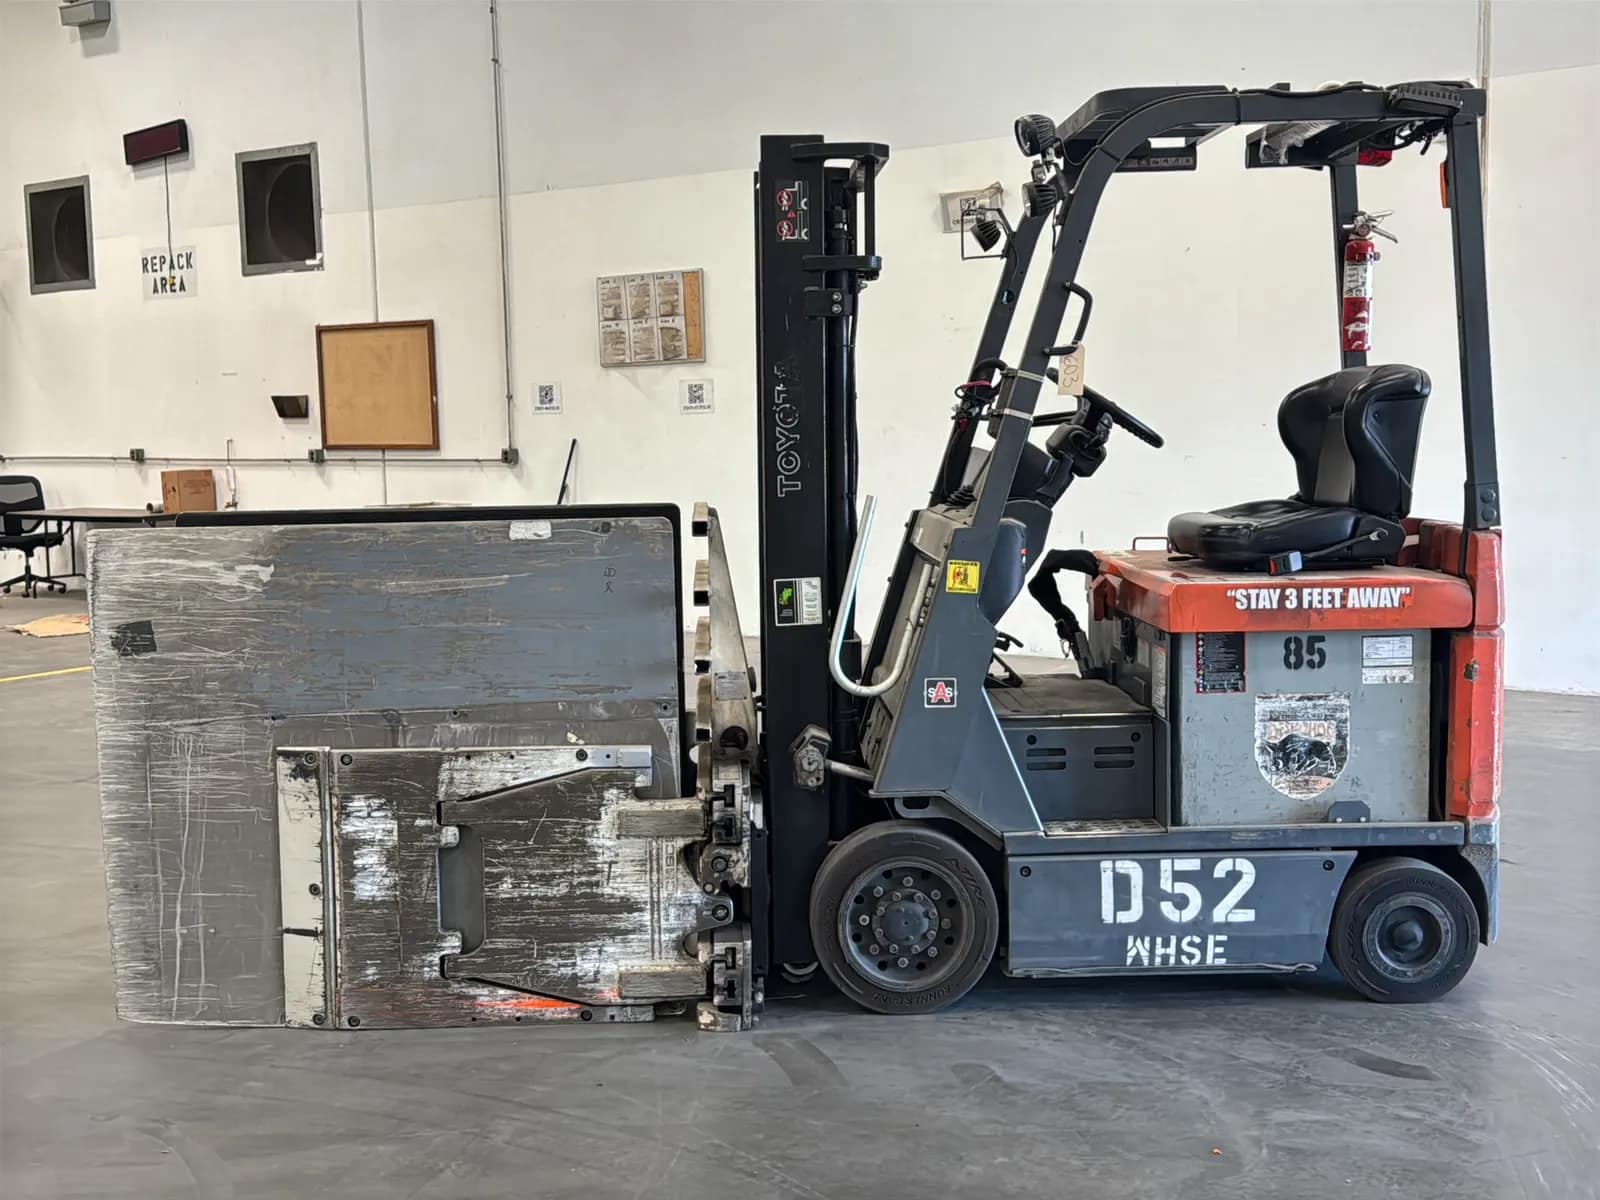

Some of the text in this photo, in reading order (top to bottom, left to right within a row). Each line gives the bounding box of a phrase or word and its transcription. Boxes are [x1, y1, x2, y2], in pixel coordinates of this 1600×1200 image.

[141, 251, 193, 274] REPACK
[152, 275, 186, 295] AREA
[1284, 587, 1298, 609] 3
[1302, 588, 1344, 609] FEET
[1283, 635, 1327, 670] 85
[927, 681, 954, 704] SAS
[1100, 857, 1257, 925] D52
[1125, 934, 1229, 966] WHSE
